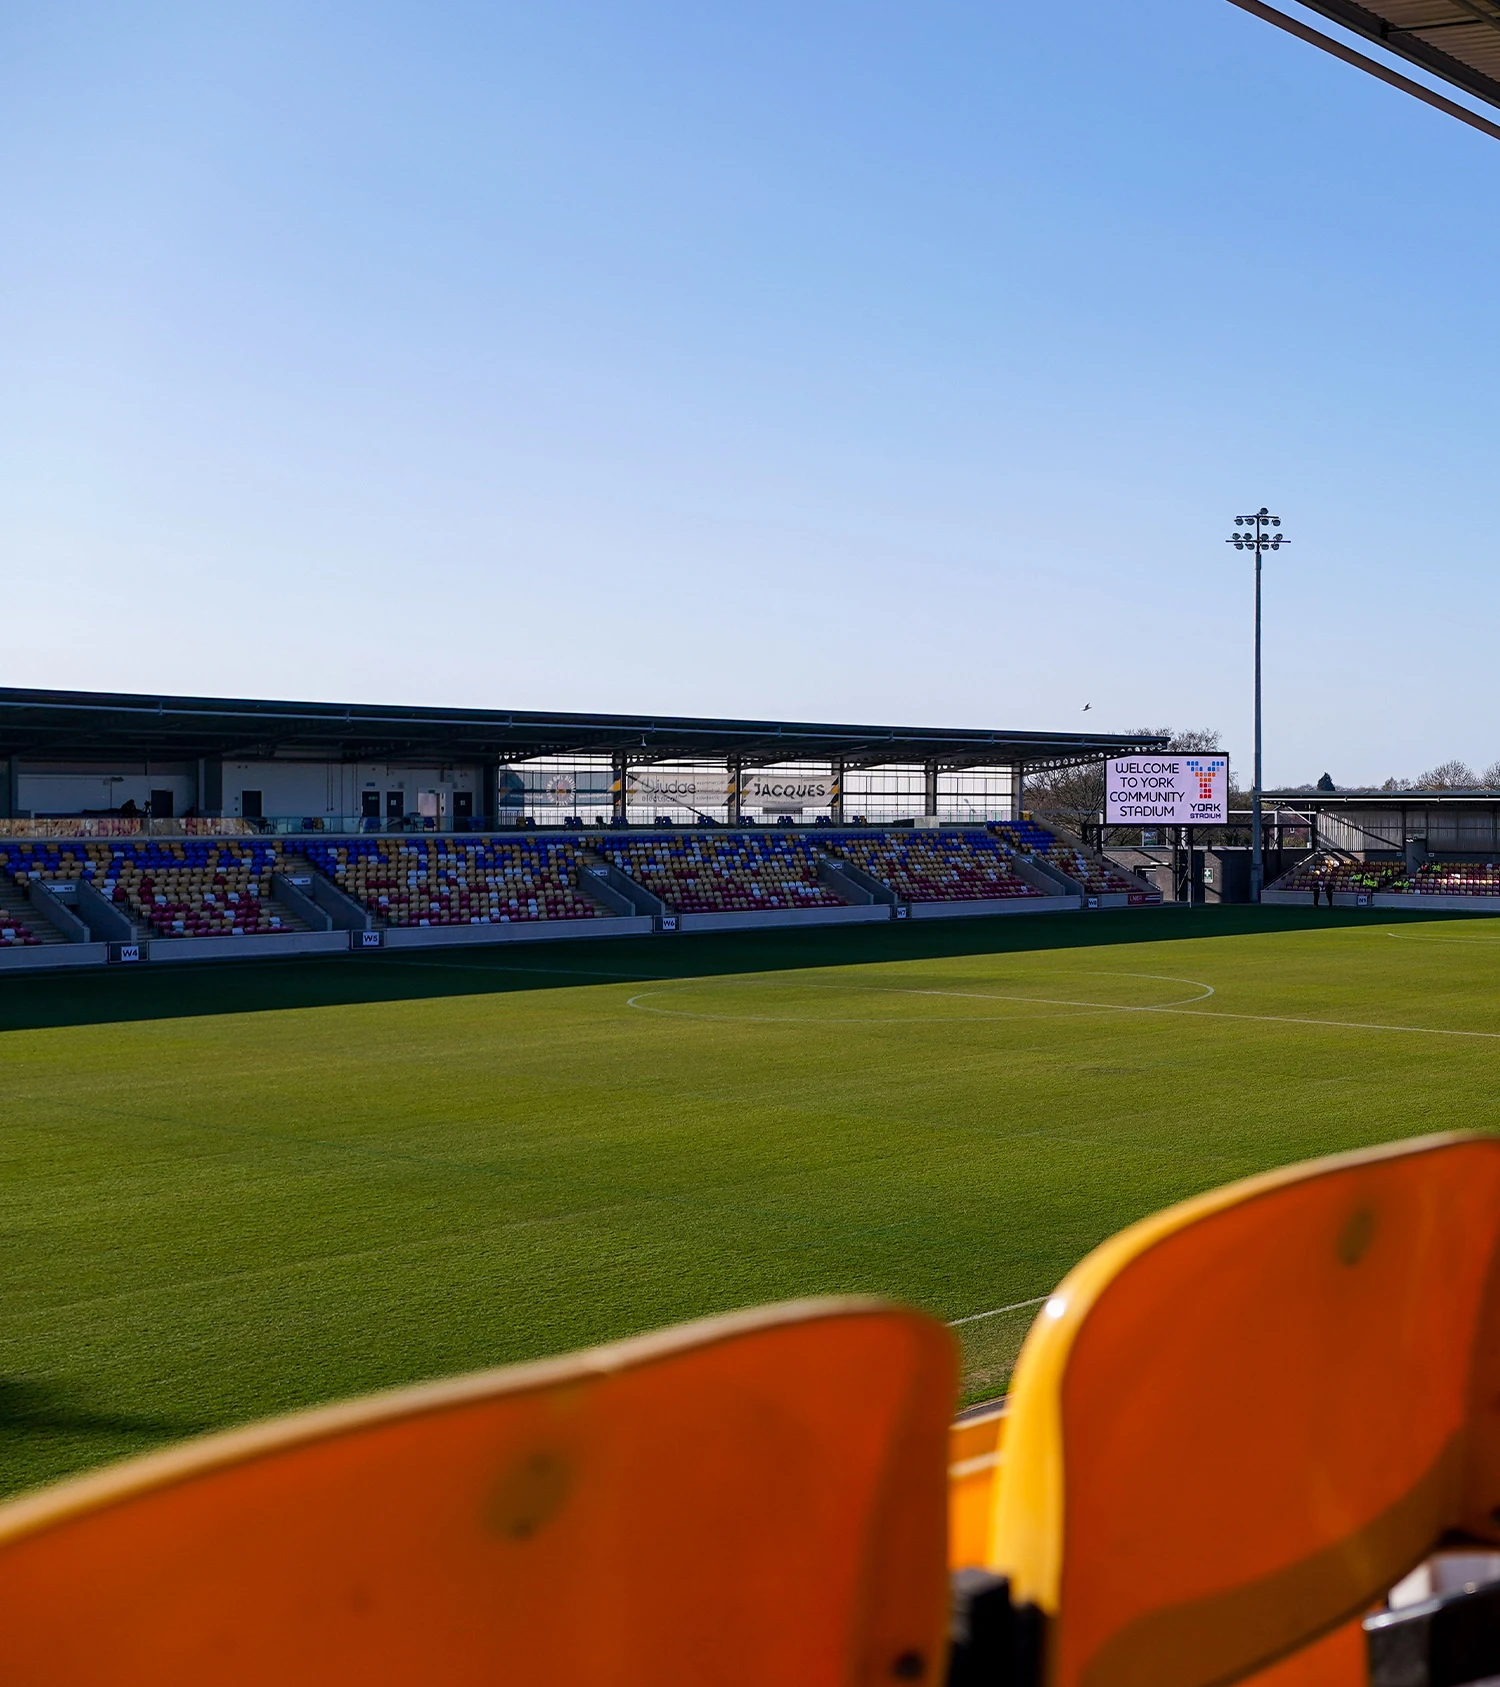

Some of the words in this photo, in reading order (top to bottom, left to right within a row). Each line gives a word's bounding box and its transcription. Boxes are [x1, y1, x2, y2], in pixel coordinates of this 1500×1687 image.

[1115, 762, 1180, 774] WELCOME
[653, 779, 697, 797] judge
[1120, 777, 1138, 788] TO
[1140, 777, 1175, 788] YORK
[753, 783, 826, 799] JACQUES
[1109, 791, 1186, 803] COMMUNITY
[1120, 805, 1175, 817] STADIUM
[1189, 803, 1221, 812] YORK
[122, 949, 138, 958] W4
